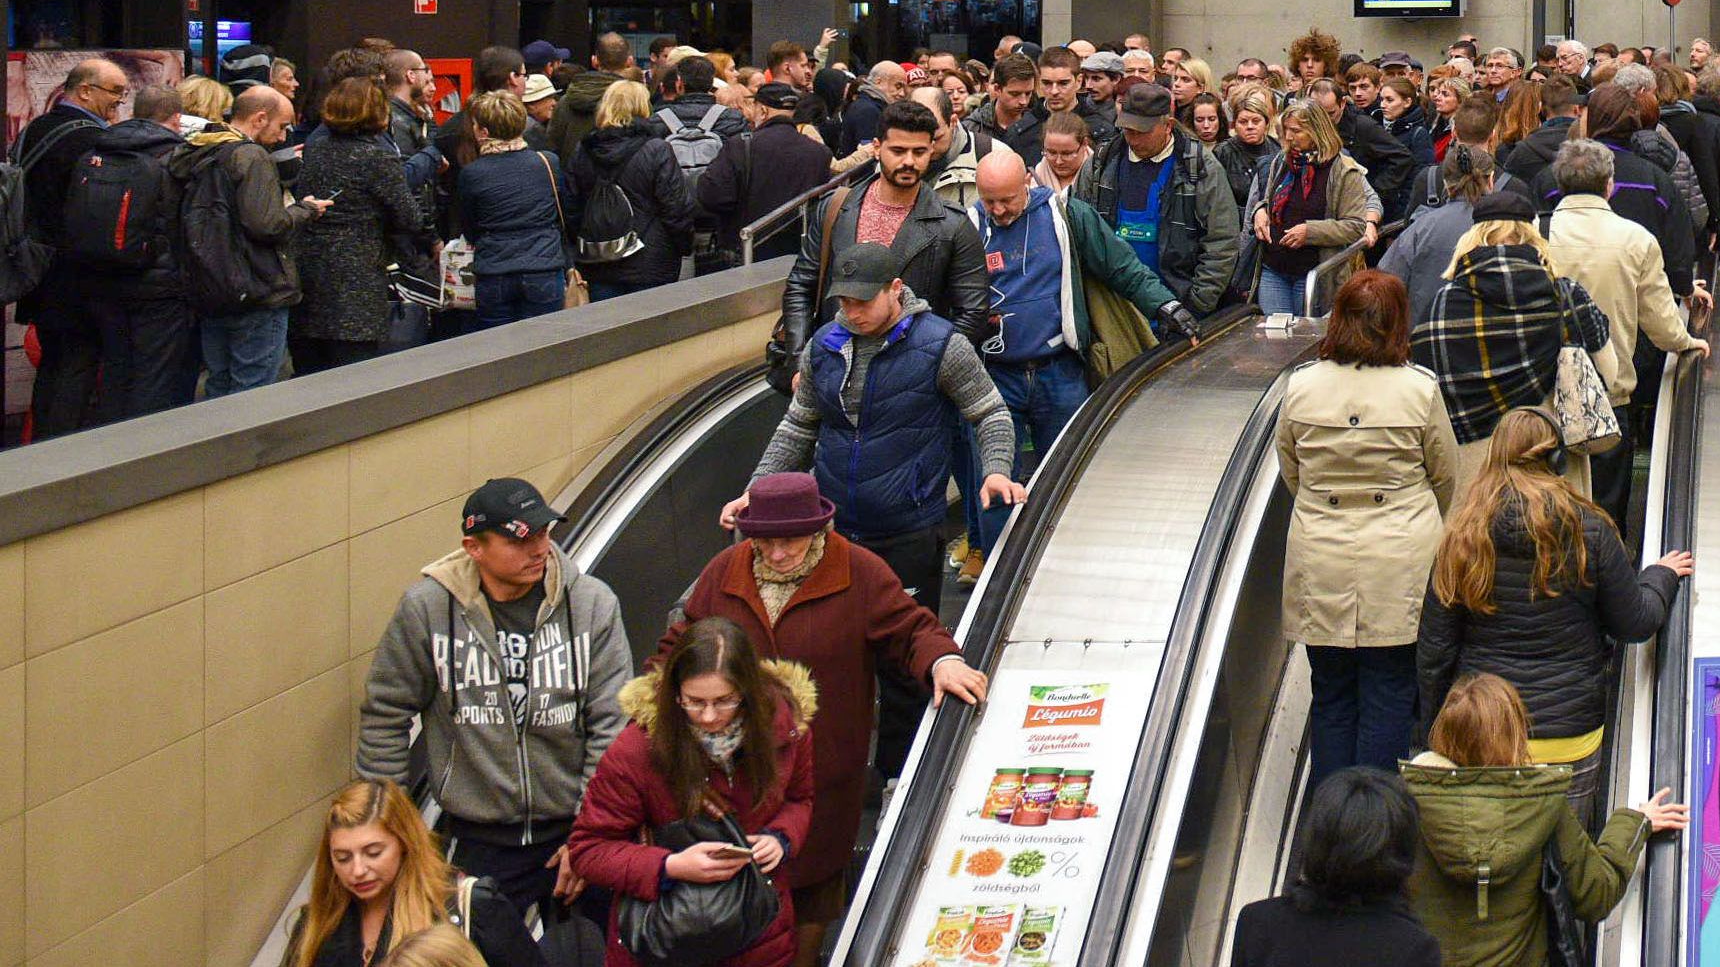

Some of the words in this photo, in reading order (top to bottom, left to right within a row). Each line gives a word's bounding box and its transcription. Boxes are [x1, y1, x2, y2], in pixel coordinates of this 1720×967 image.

[1046, 692, 1092, 702] Bonduelle
[454, 705, 505, 724] SPORTS
[1030, 706, 1098, 724] Légumio
[960, 833, 1011, 844] Inspiráló
[1013, 834, 1086, 845] újdonságok
